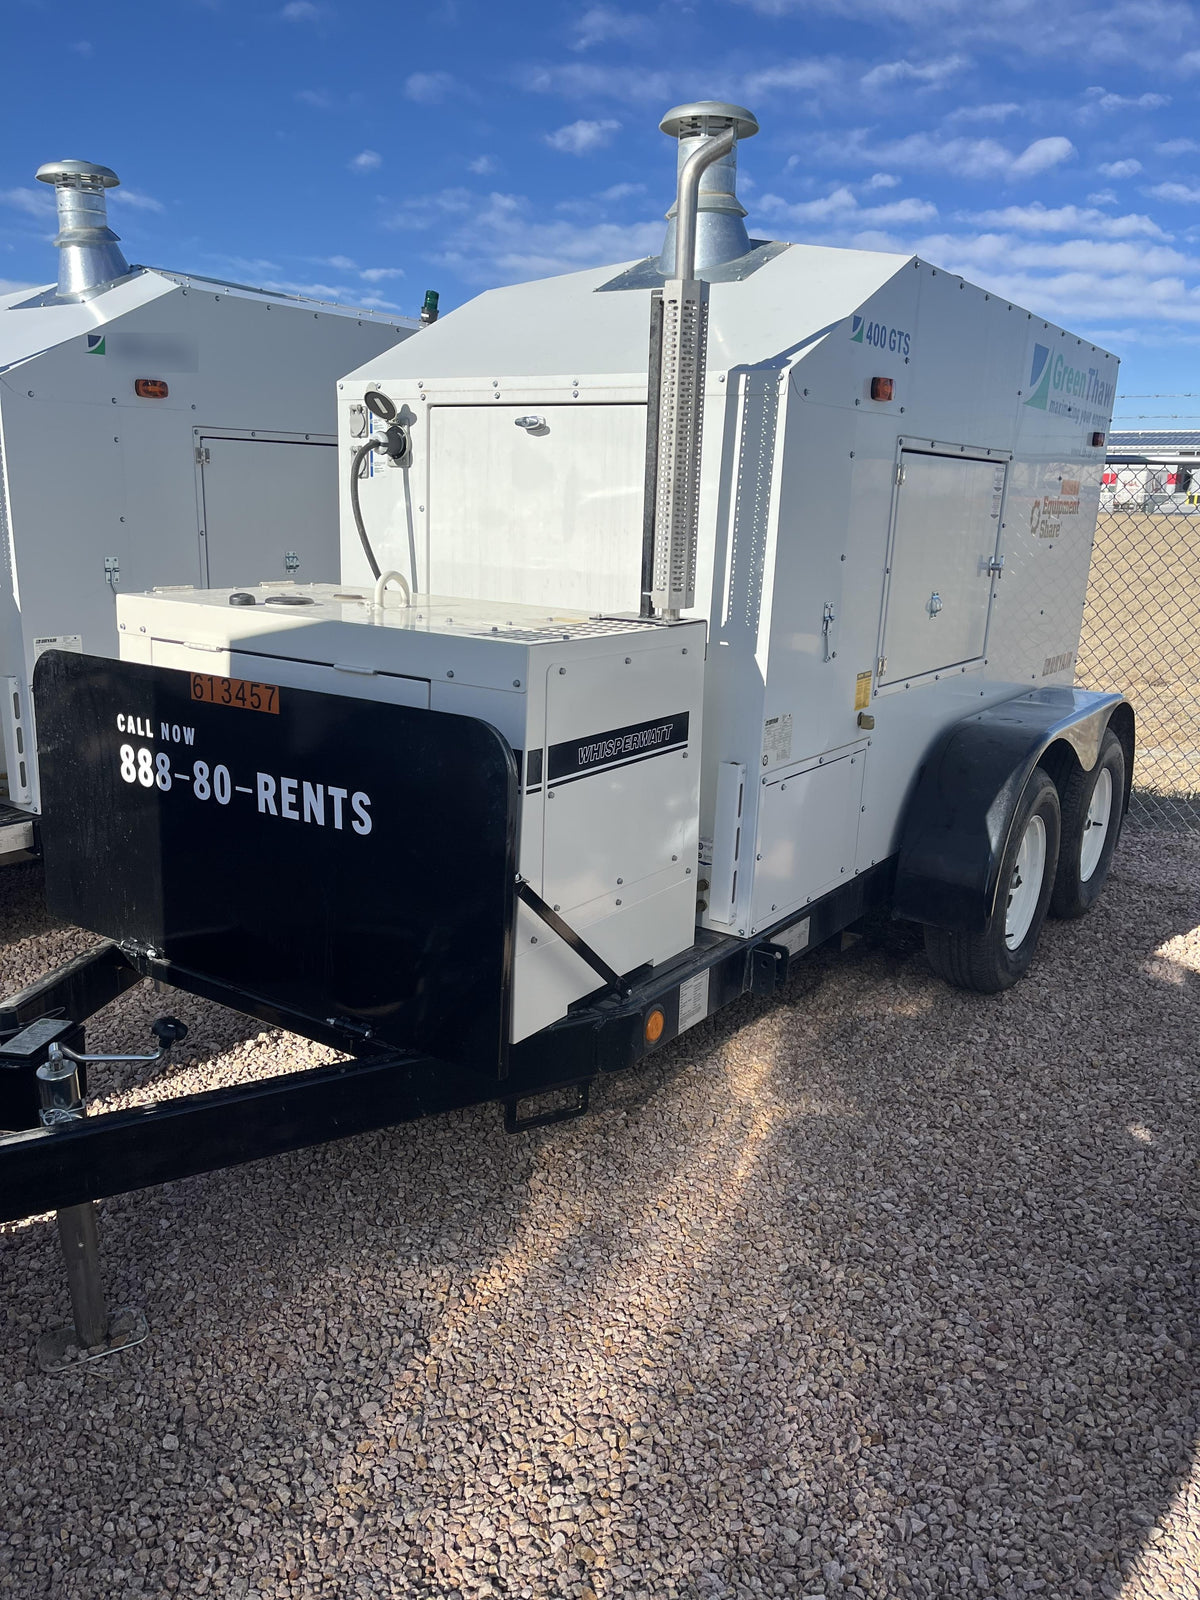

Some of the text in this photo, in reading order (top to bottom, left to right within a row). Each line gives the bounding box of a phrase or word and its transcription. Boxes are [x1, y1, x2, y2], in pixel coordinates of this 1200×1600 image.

[866, 321, 911, 355] 400 GTS
[1042, 496, 1080, 519] Equipment
[1039, 519, 1061, 539] Share
[193, 674, 276, 711] 613457
[116, 713, 195, 746] CALL NOW
[578, 723, 673, 765] WHISPERWATT
[119, 743, 373, 836] 888-80-RENTS
